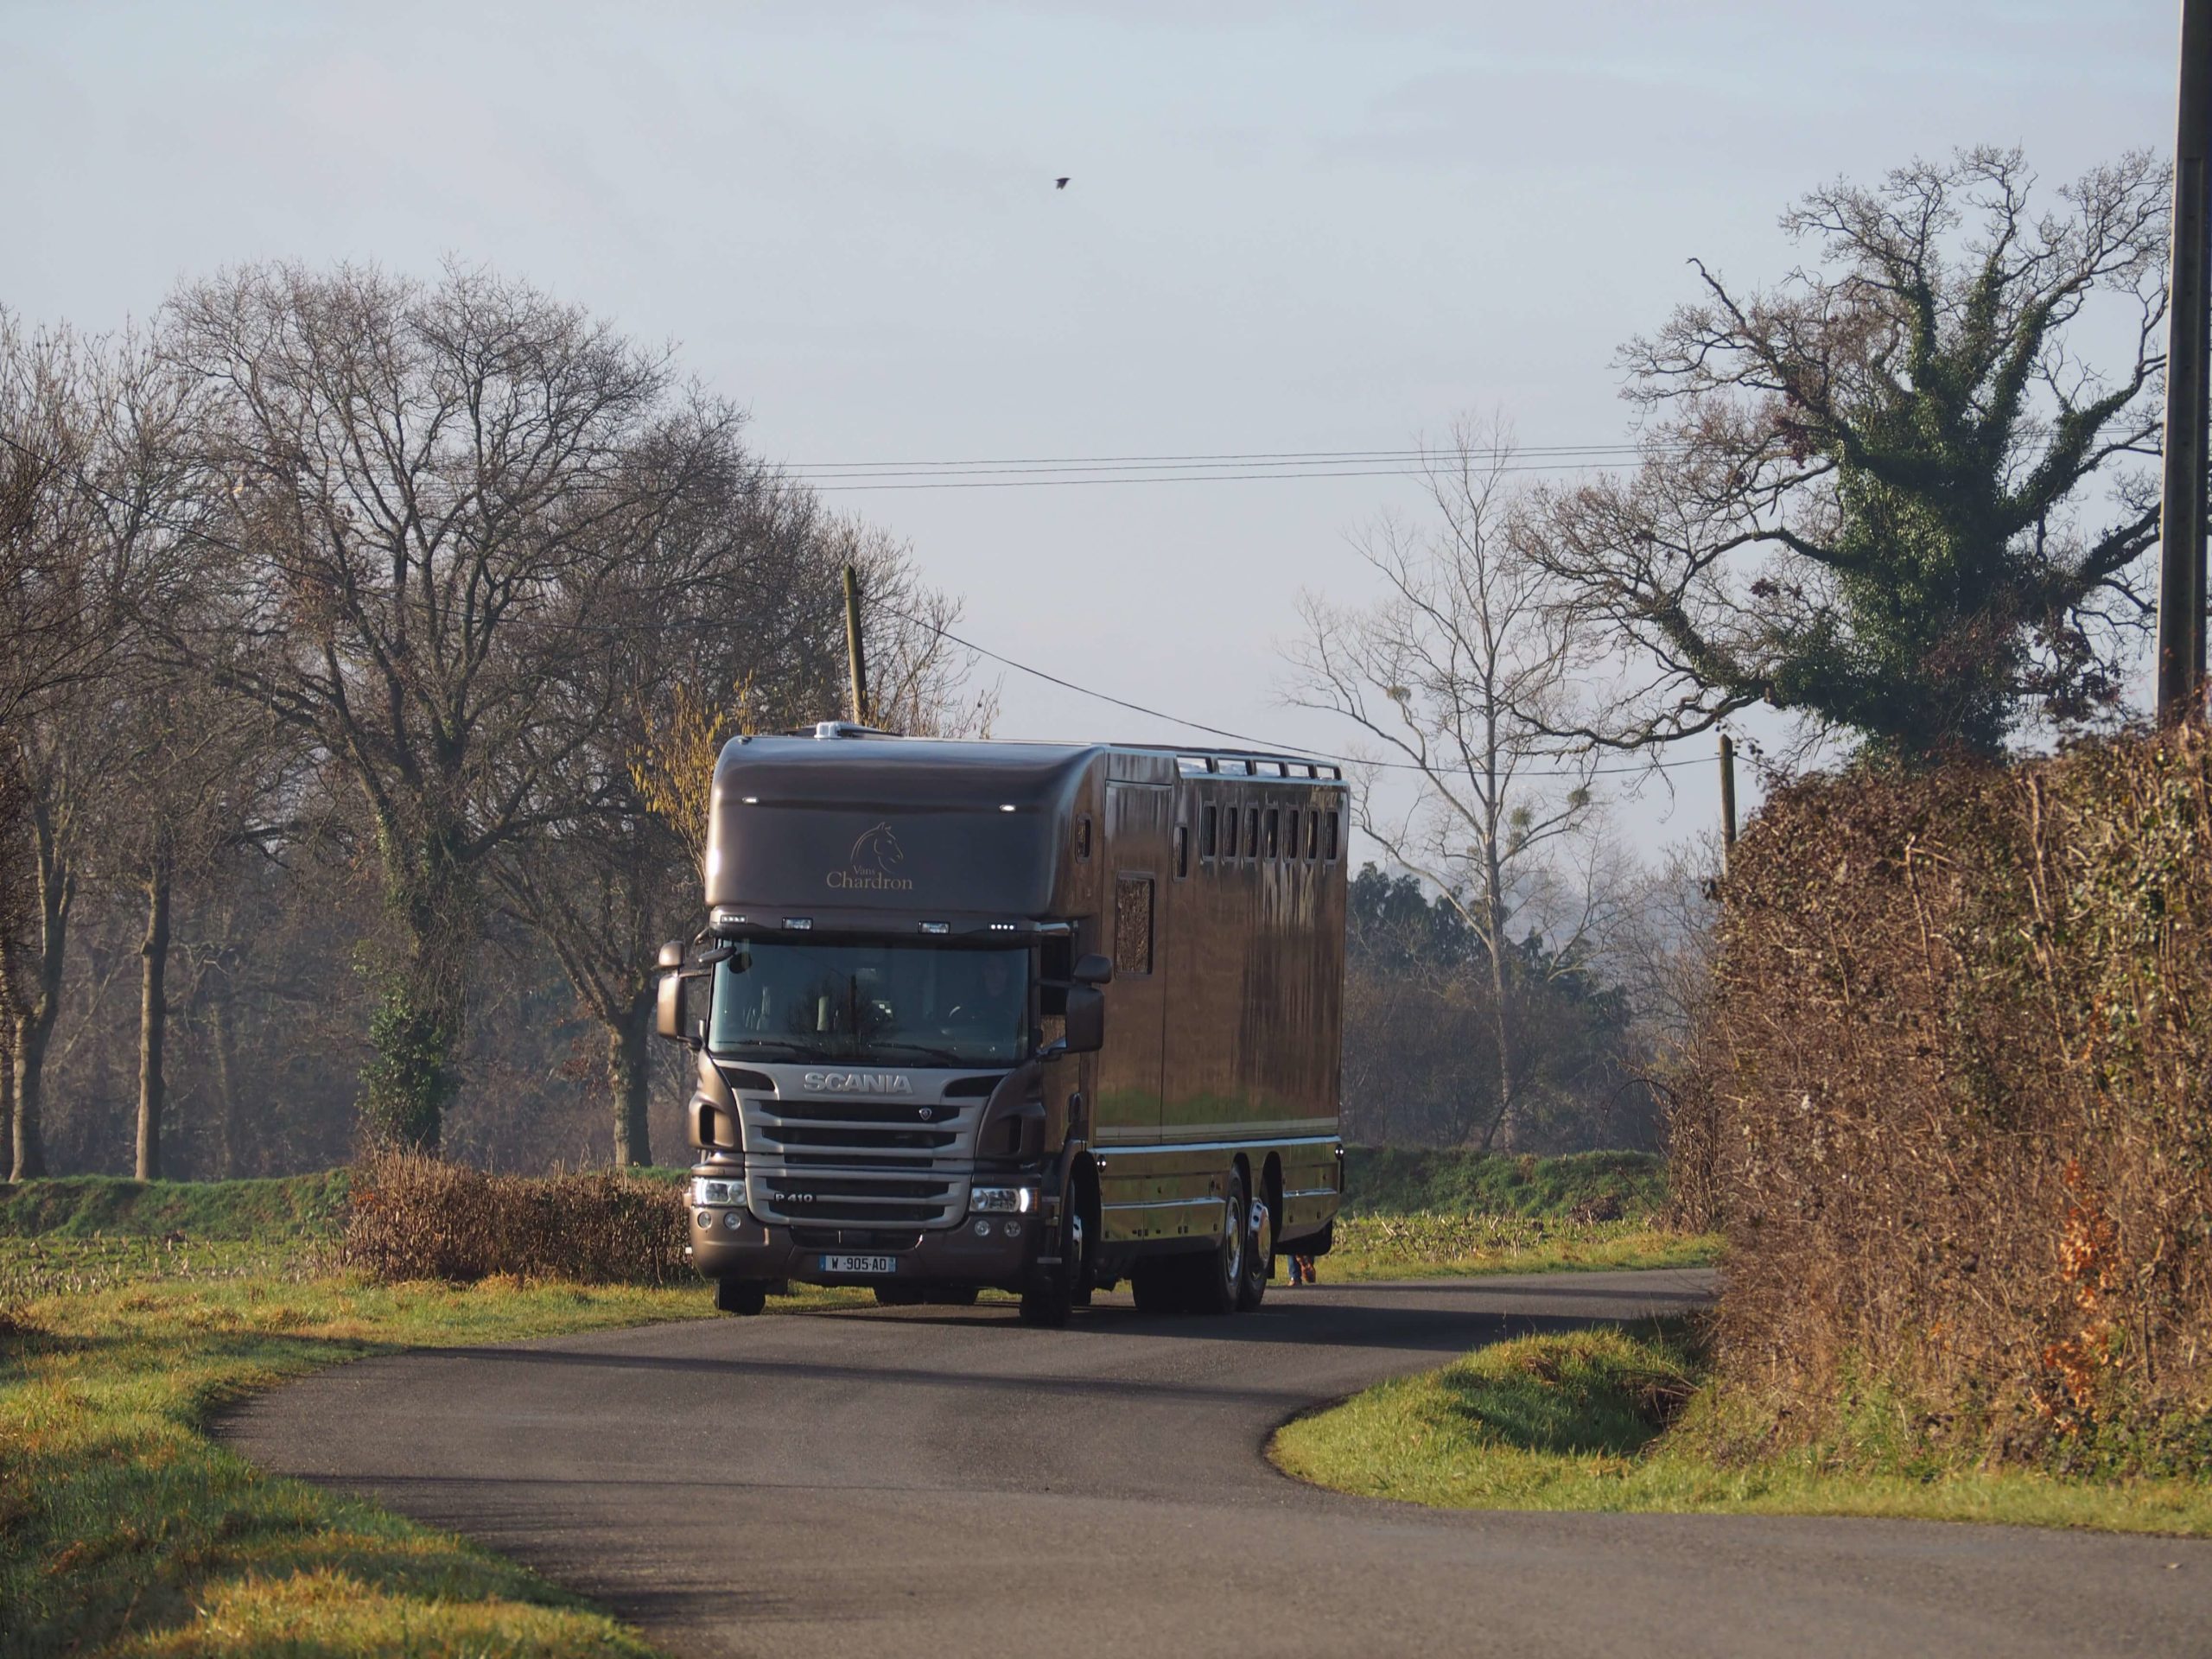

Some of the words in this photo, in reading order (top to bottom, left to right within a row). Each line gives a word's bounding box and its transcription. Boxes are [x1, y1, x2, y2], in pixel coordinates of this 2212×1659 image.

[853, 865, 875, 874] Vans
[826, 871, 912, 889] Chardron
[804, 1072, 913, 1093] SCANIA
[775, 1193, 785, 1202] P
[787, 1193, 813, 1202] 410
